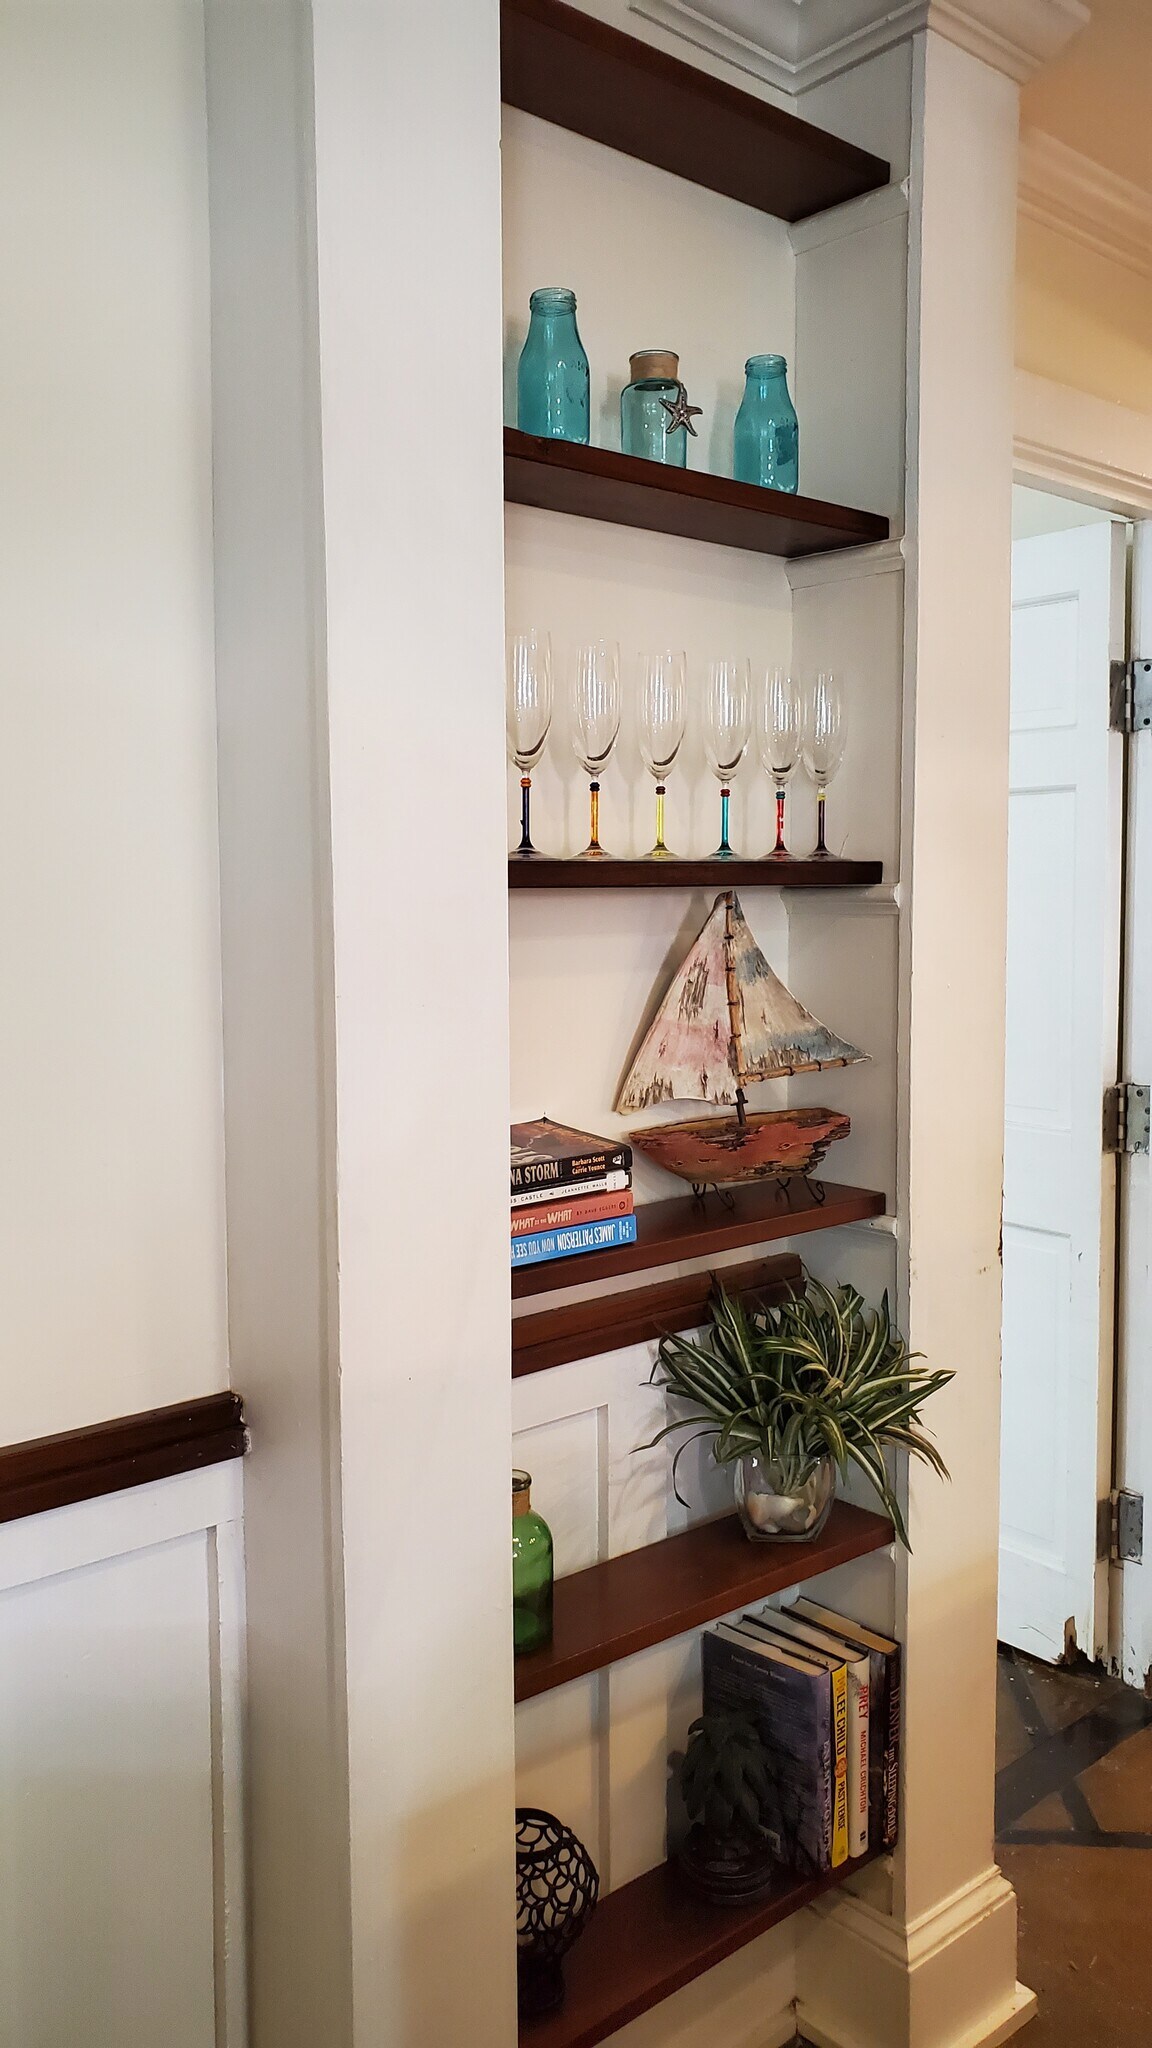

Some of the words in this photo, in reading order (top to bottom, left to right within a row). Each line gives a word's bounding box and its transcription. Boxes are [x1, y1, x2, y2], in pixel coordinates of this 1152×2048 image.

[525, 1161, 559, 1184] STORM
[572, 1158, 592, 1167] Barbara
[572, 1166, 587, 1174] Carrie
[588, 1164, 605, 1172] Younce
[520, 1193, 543, 1202] CASTLE
[561, 1184, 589, 1194] JEANNETTE
[511, 1217, 535, 1231] WHAT
[547, 1209, 573, 1224] WHAT
[557, 1228, 594, 1251] PATTERSON
[594, 1223, 616, 1243] JAMES
[515, 1242, 528, 1258] SEE
[528, 1240, 541, 1256] YOU
[541, 1237, 555, 1253] NOW
[836, 1691, 846, 1717] LEE
[858, 1683, 868, 1719] PREY
[889, 1687, 900, 1748] DEAVER
[836, 1717, 846, 1756] CHILD
[837, 1780, 846, 1803] PAST
[887, 1762, 898, 1810] SLEEPING
[837, 1803, 846, 1831] TENSE
